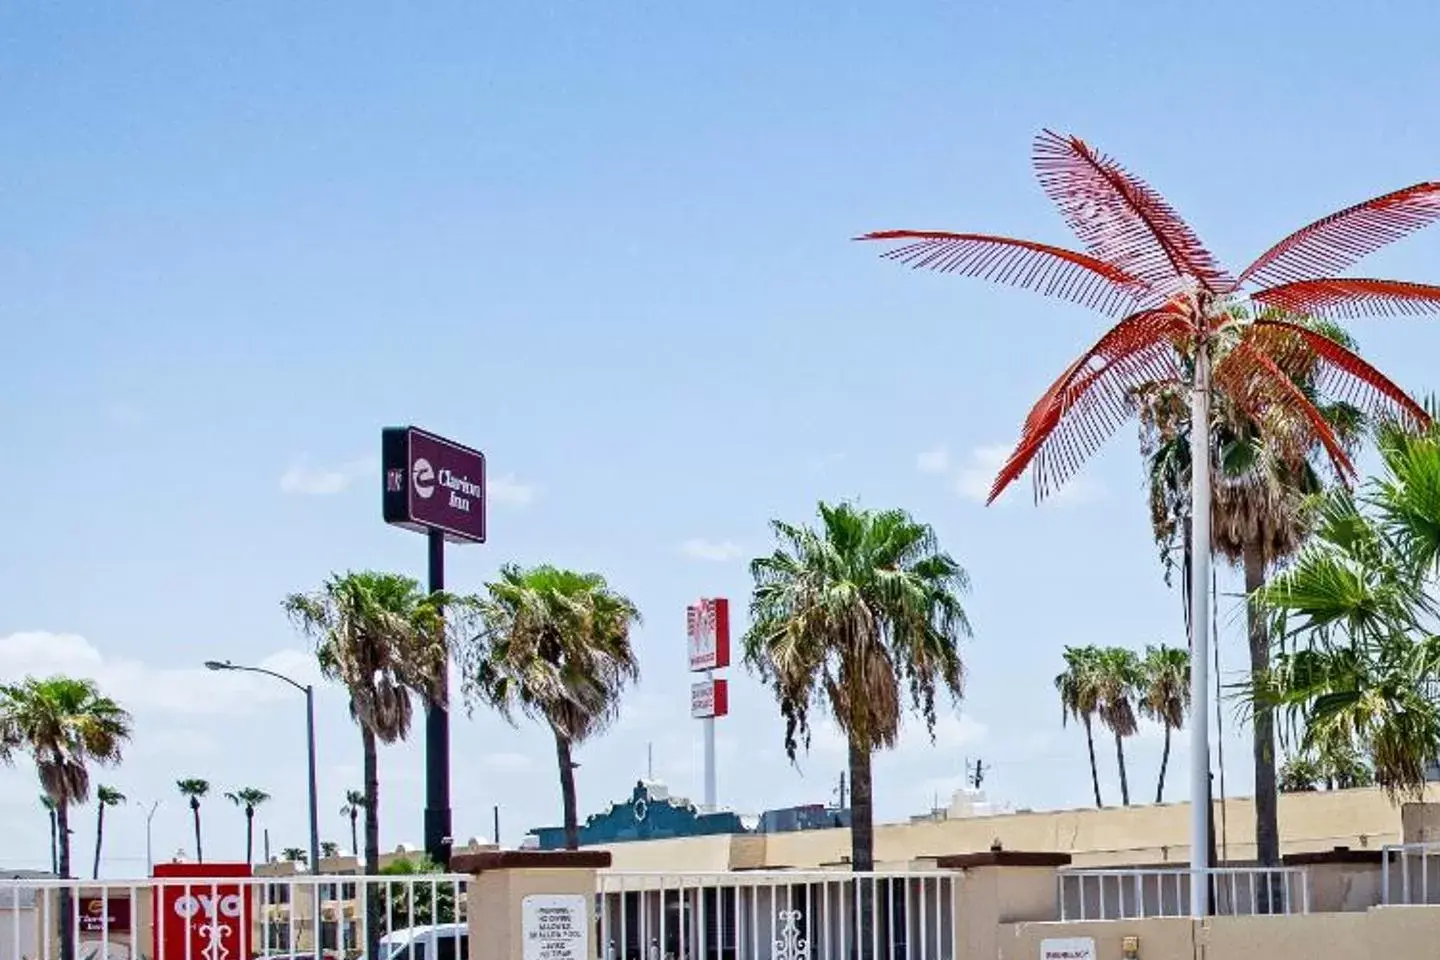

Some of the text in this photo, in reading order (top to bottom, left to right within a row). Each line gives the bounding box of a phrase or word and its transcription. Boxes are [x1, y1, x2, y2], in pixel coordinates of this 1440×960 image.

[438, 469, 481, 498] Clarion
[448, 491, 470, 511] Inn
[174, 894, 244, 919] OYO
